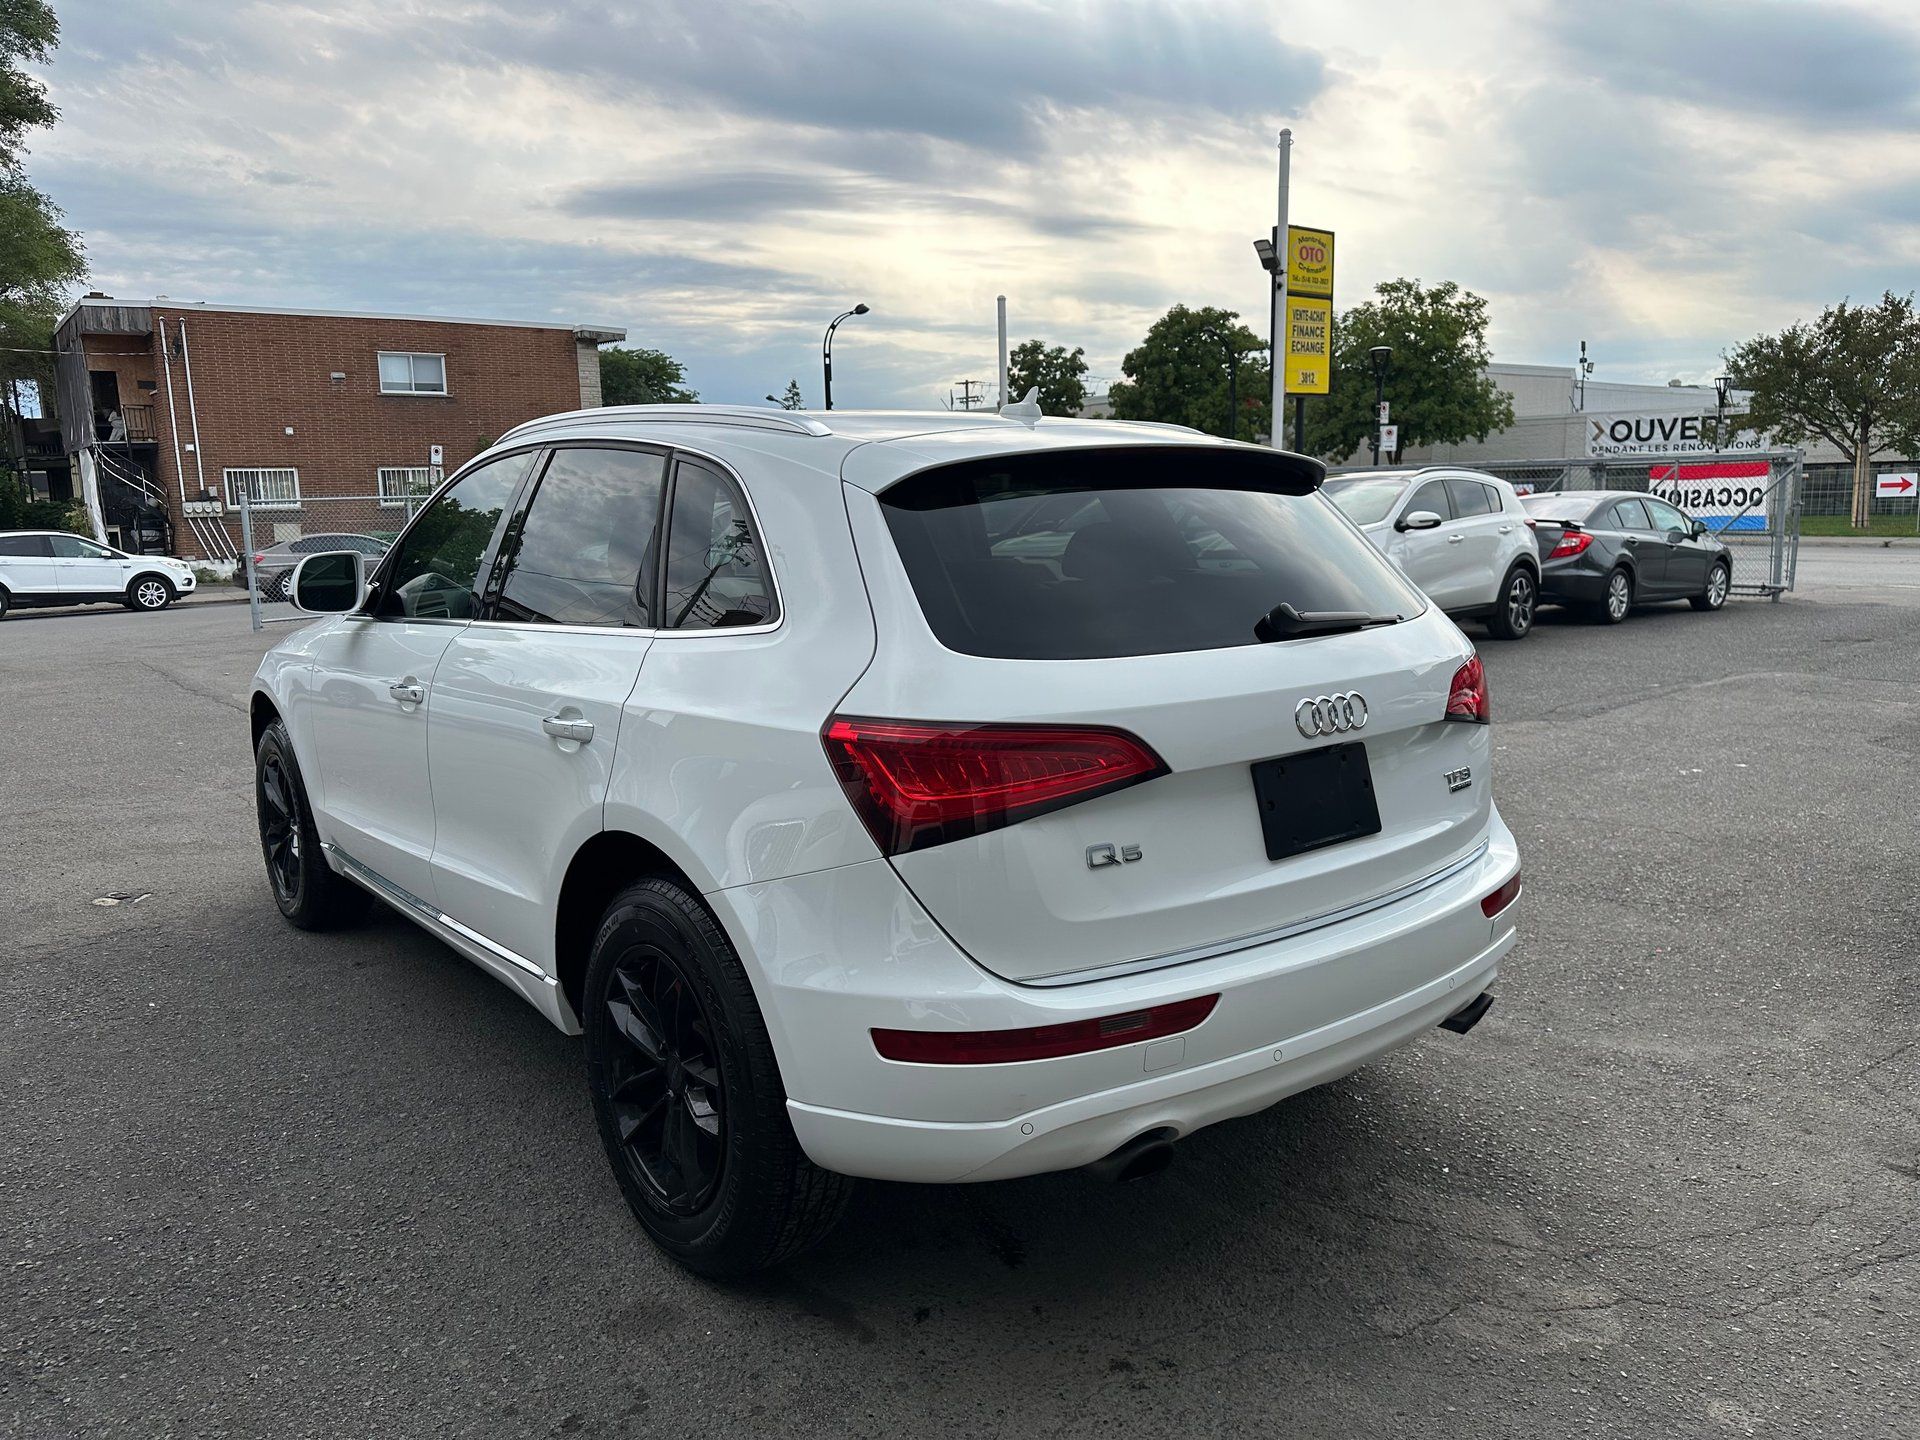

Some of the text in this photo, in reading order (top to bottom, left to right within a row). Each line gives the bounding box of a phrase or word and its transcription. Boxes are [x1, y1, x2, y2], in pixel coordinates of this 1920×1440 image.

[1299, 245, 1325, 263] OTO
[1292, 309, 1326, 322] VENTE-ACHAT
[1292, 324, 1325, 338] FINANCE
[1291, 340, 1325, 354] ECHANGE
[1609, 416, 1728, 443] OUVE
[1591, 440, 1761, 454] PENDANT LES RÉNOVIONS
[1086, 842, 1143, 871] Q5
